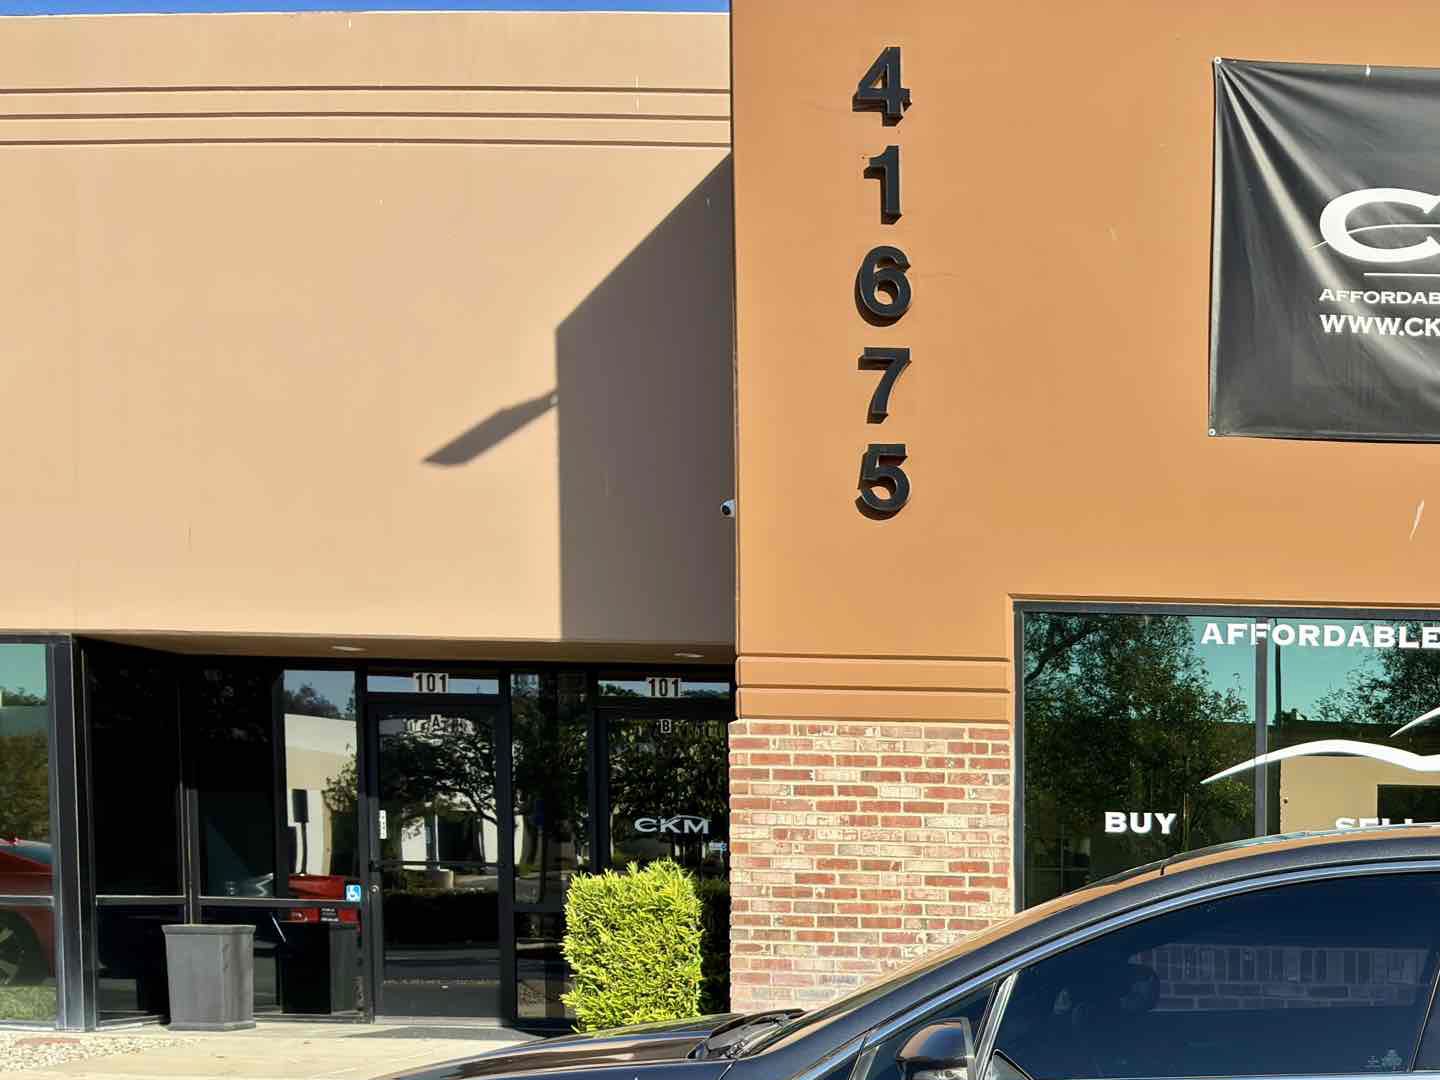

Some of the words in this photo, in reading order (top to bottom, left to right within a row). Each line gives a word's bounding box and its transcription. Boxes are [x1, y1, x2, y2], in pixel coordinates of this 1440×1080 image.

[852, 46, 912, 521] 41675
[415, 673, 447, 692] 101
[649, 678, 679, 697] 101
[634, 817, 709, 834] CKM
[1104, 811, 1176, 834] BUY
